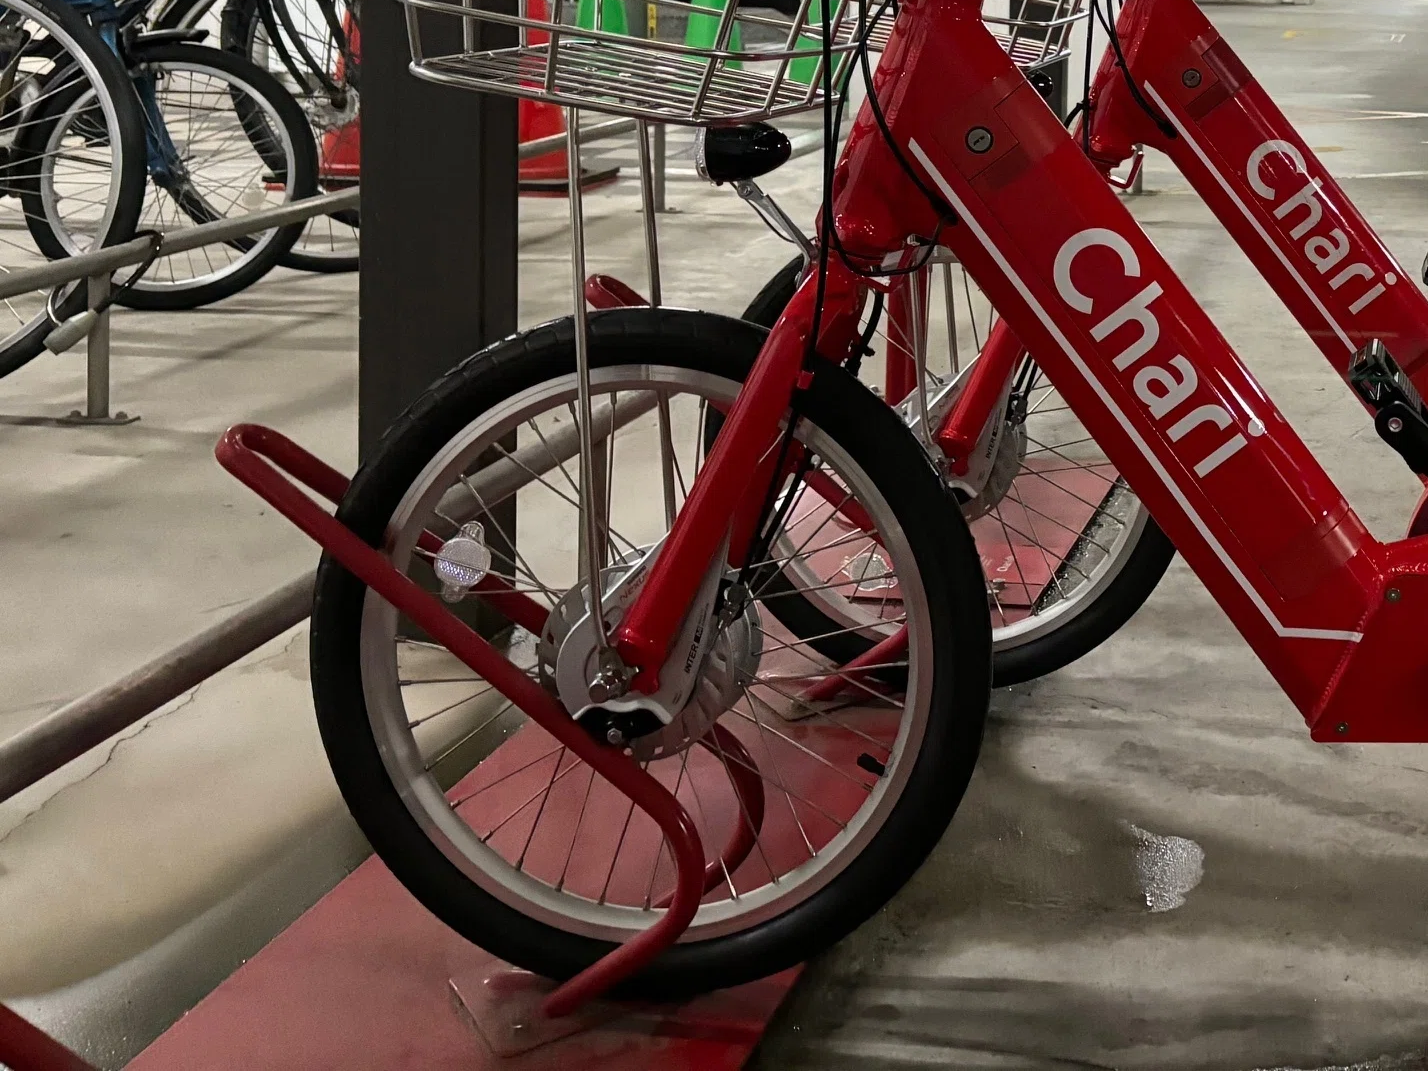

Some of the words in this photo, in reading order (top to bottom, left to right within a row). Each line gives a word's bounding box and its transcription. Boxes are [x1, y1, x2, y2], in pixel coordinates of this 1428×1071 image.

[1246, 139, 1398, 315] Chari
[1053, 227, 1266, 479] Chari
[684, 644, 699, 674] INTER
